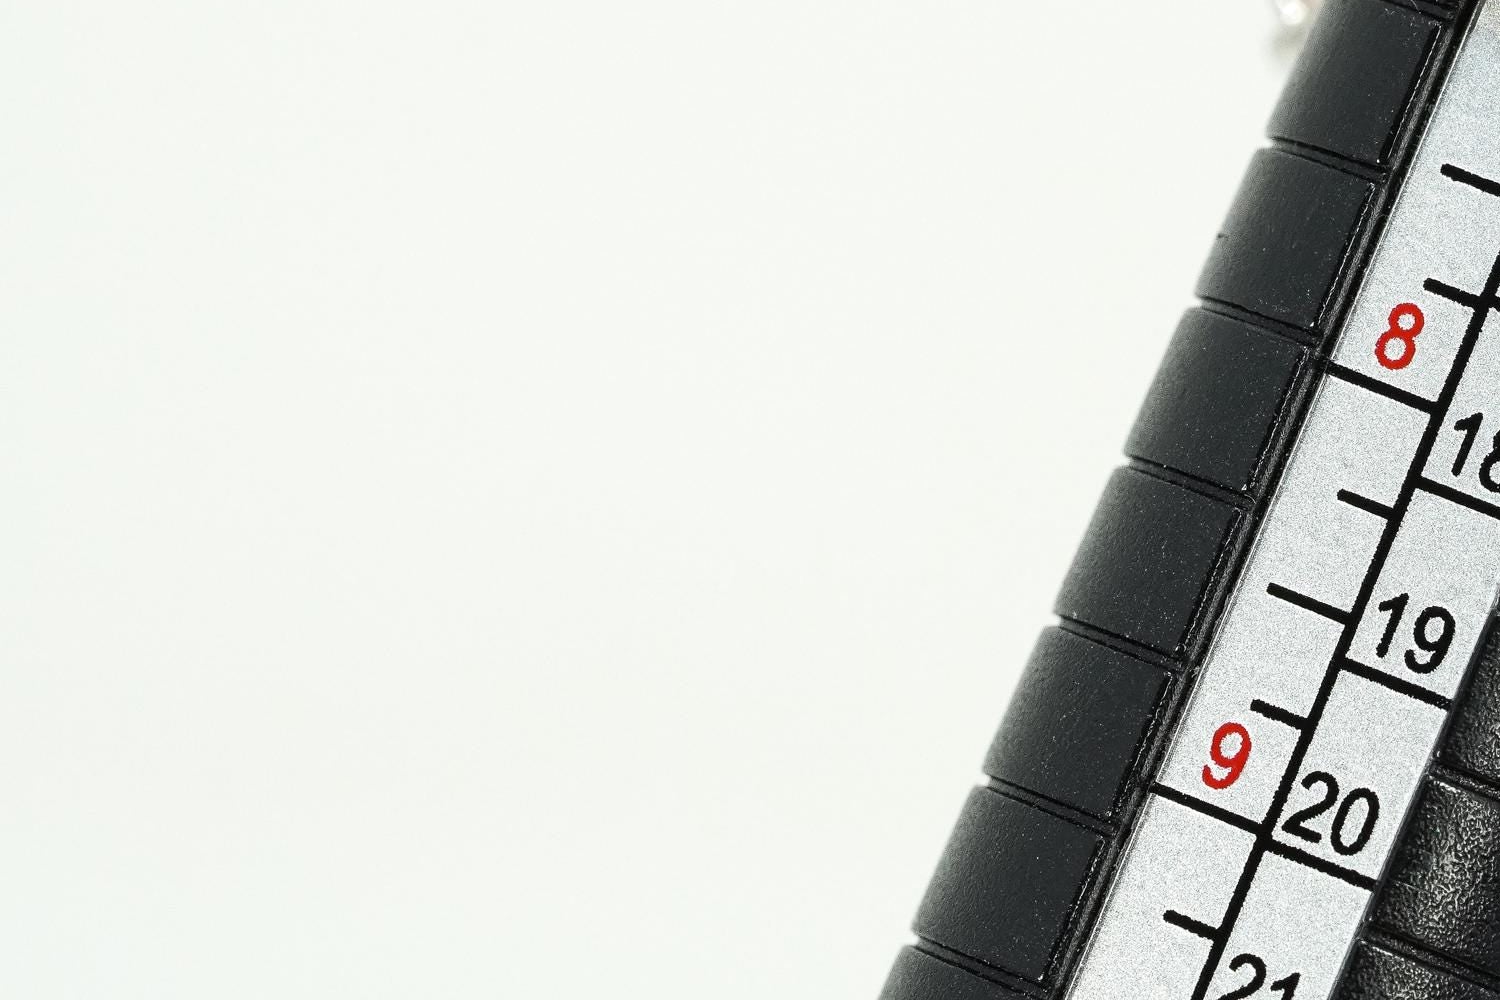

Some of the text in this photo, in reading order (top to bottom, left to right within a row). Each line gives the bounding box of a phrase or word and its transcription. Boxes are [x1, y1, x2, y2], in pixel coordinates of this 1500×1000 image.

[1374, 302, 1425, 371] 8
[1375, 592, 1456, 675] 19
[1201, 722, 1252, 790] 9
[1281, 770, 1381, 857] 20
